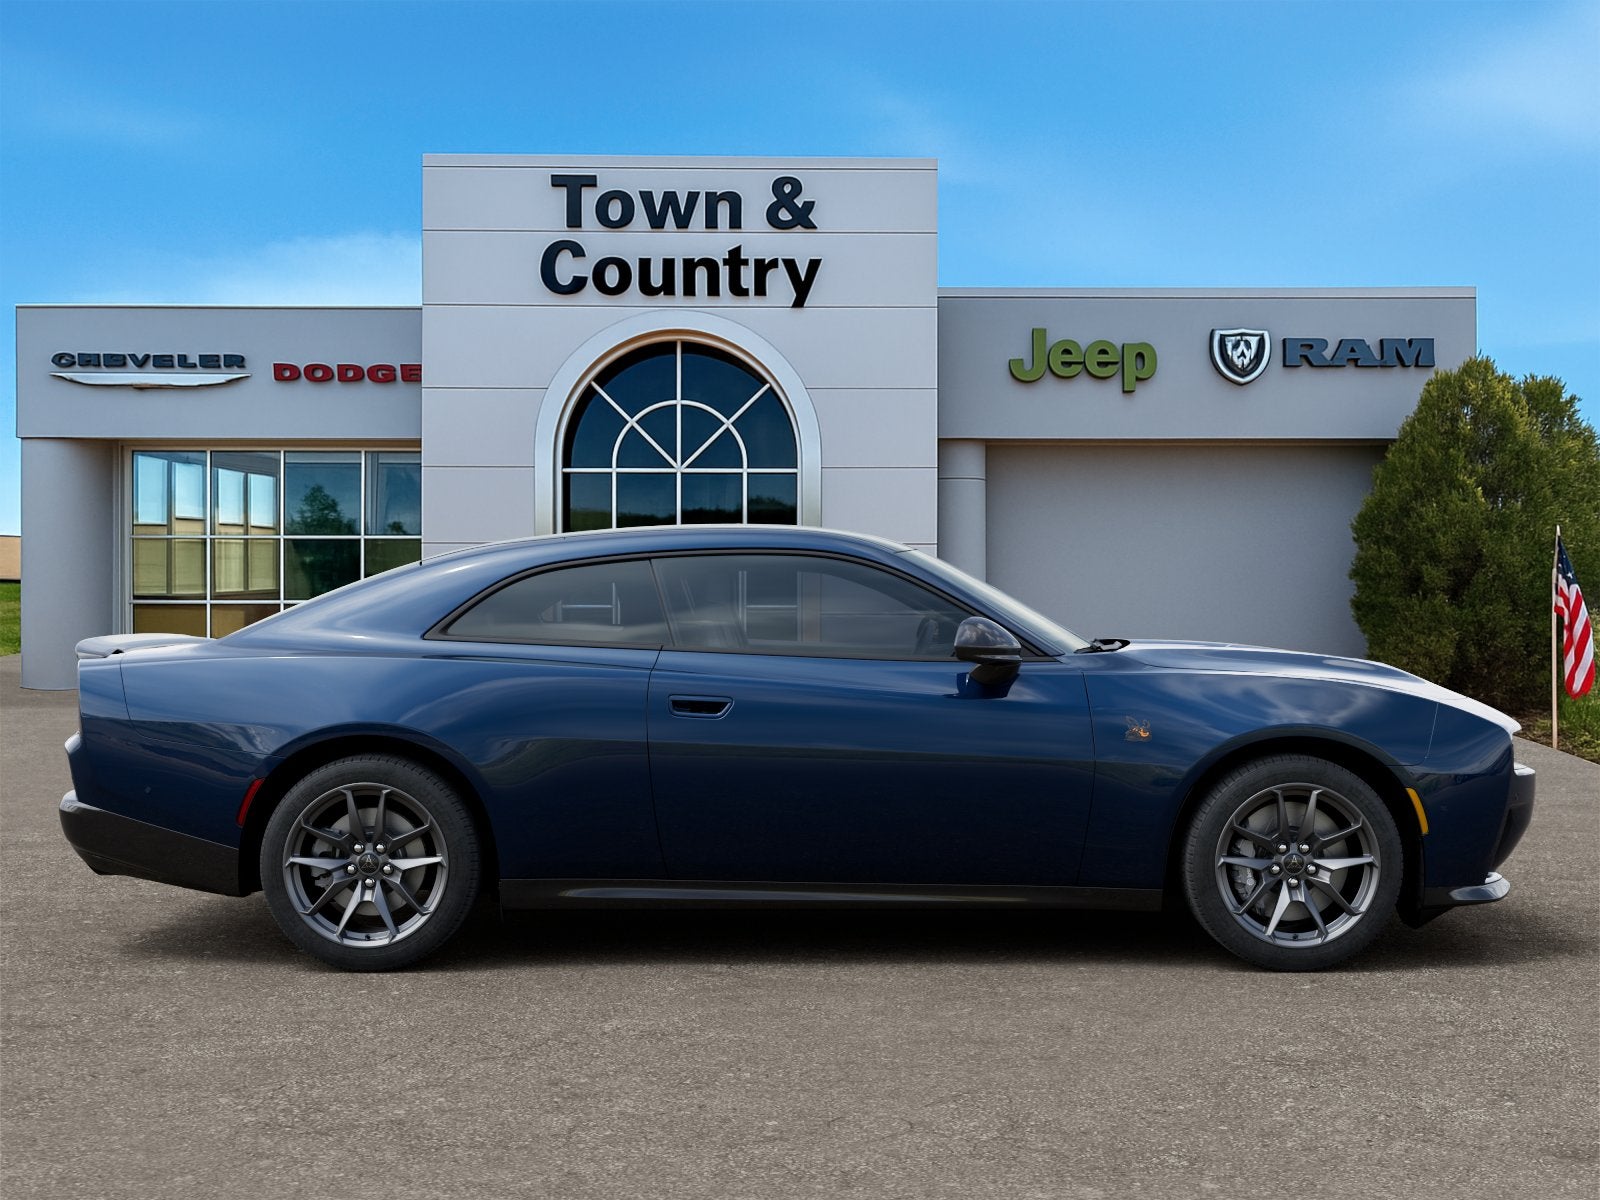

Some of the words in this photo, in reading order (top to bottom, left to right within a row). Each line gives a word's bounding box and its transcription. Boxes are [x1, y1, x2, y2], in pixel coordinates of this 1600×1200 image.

[550, 174, 742, 229] Town
[765, 176, 818, 229] &
[540, 240, 822, 308] Country
[272, 363, 422, 383] DODGE
[1008, 327, 1158, 393] Jeep
[1282, 337, 1436, 368] RAM
